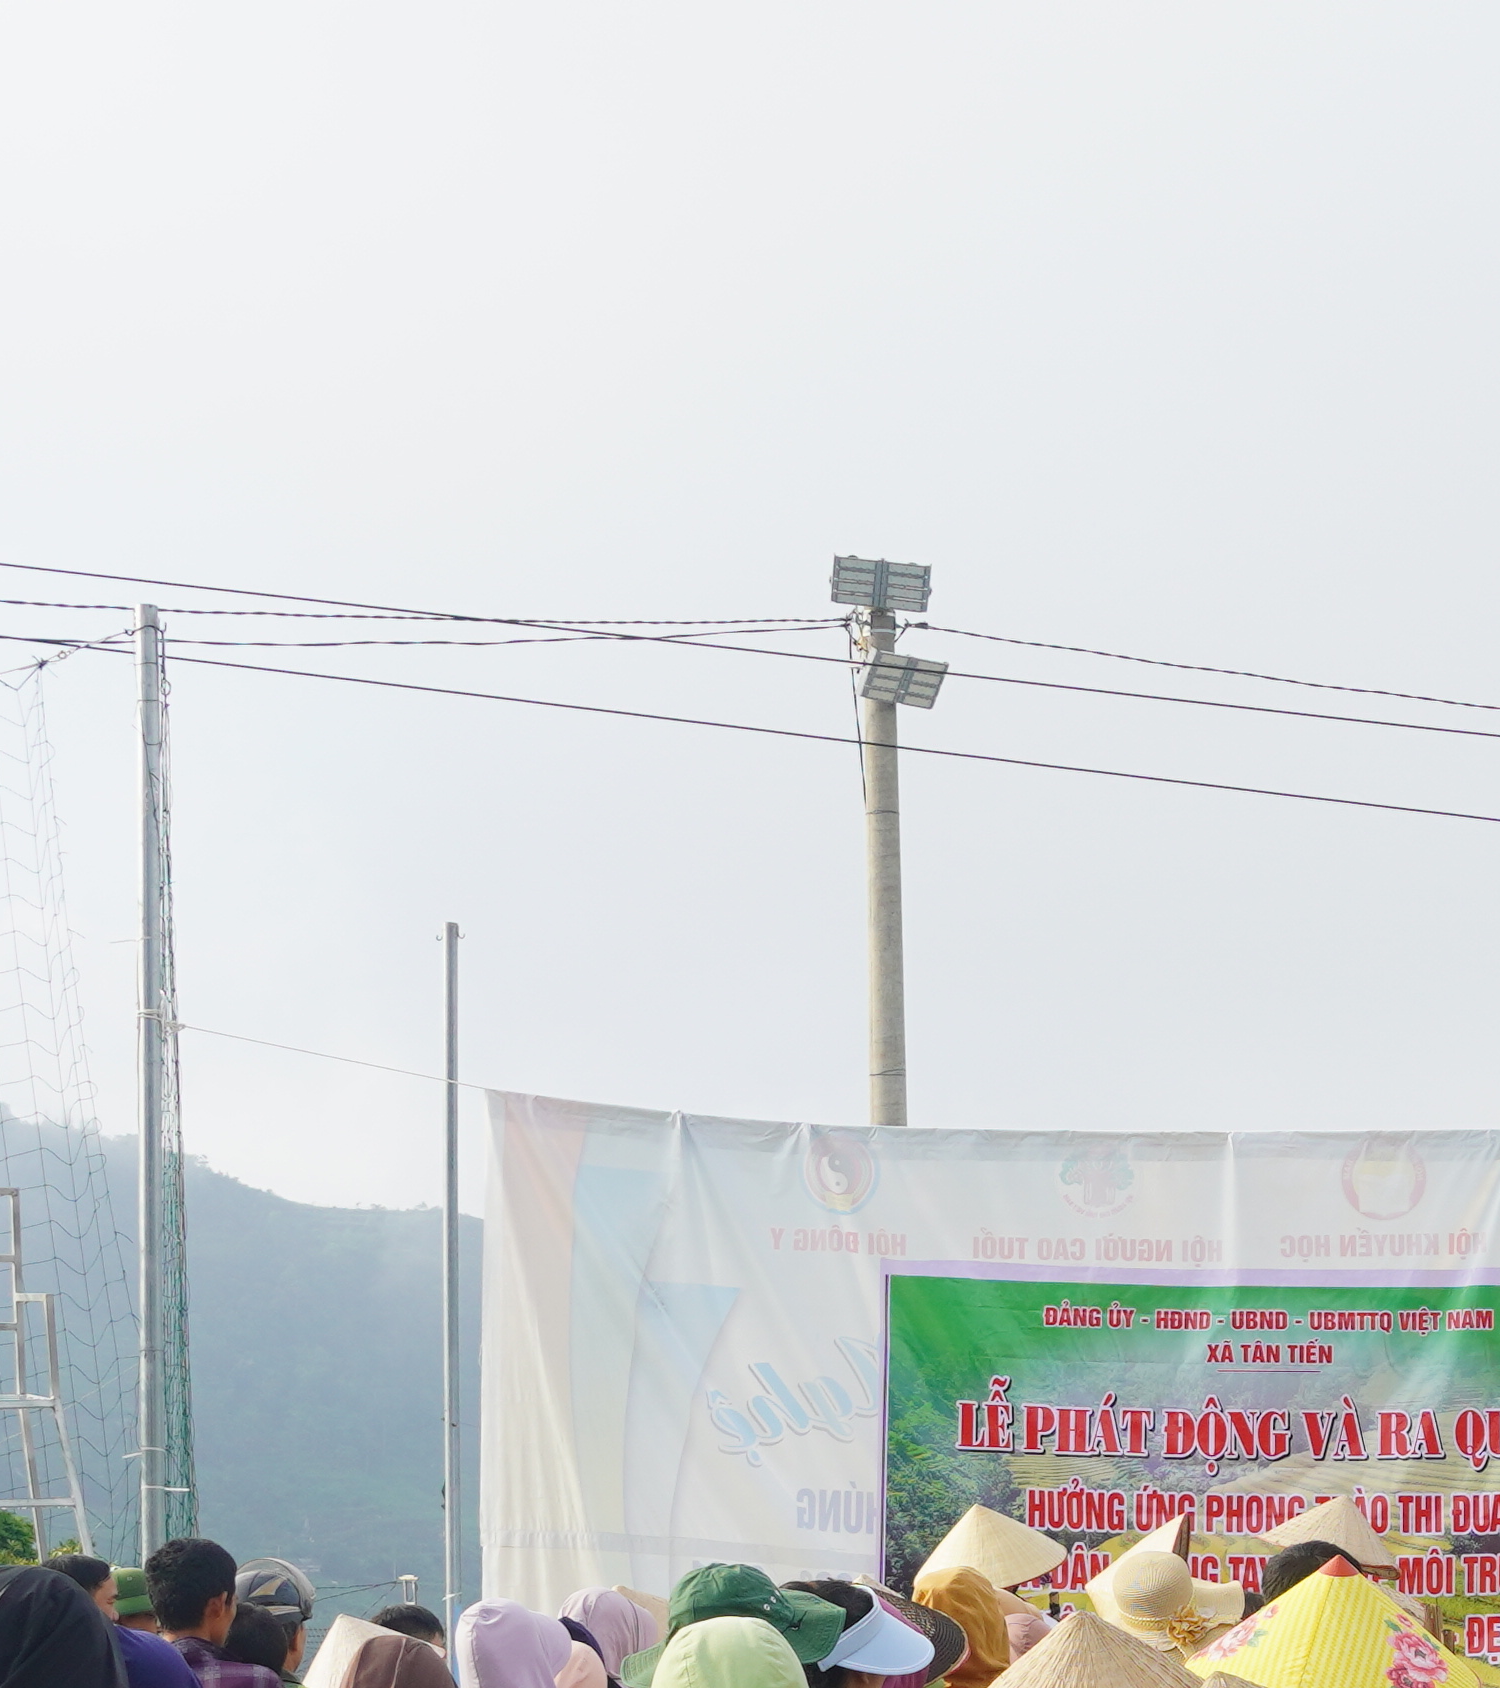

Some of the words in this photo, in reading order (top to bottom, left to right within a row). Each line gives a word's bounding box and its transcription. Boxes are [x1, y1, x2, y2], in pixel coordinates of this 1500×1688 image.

[1044, 1300, 1102, 1329] ĐẢNG
[1106, 1300, 1136, 1329] ỦY
[1155, 1308, 1213, 1331] HĐND
[1230, 1308, 1290, 1331] UBND
[1308, 1308, 1393, 1334] UBMTTQ
[1398, 1307, 1442, 1336] VIỆT
[1446, 1308, 1494, 1331] NAM
[1206, 1339, 1235, 1364] XÃ
[1239, 1339, 1282, 1364] TÂN
[1287, 1337, 1334, 1364] TIẾN
[956, 1375, 1014, 1453] LỄ
[1021, 1391, 1154, 1458] PHÁT
[1162, 1394, 1292, 1476] ĐỘNG
[1302, 1396, 1366, 1460] VÀ
[1377, 1409, 1446, 1461] RA
[1026, 1475, 1127, 1533] HƯỞNG
[1135, 1484, 1197, 1533] ỨNG
[1206, 1493, 1307, 1534] PHONG
[1398, 1494, 1444, 1535] THI
[1398, 1547, 1456, 1597] MÔI
